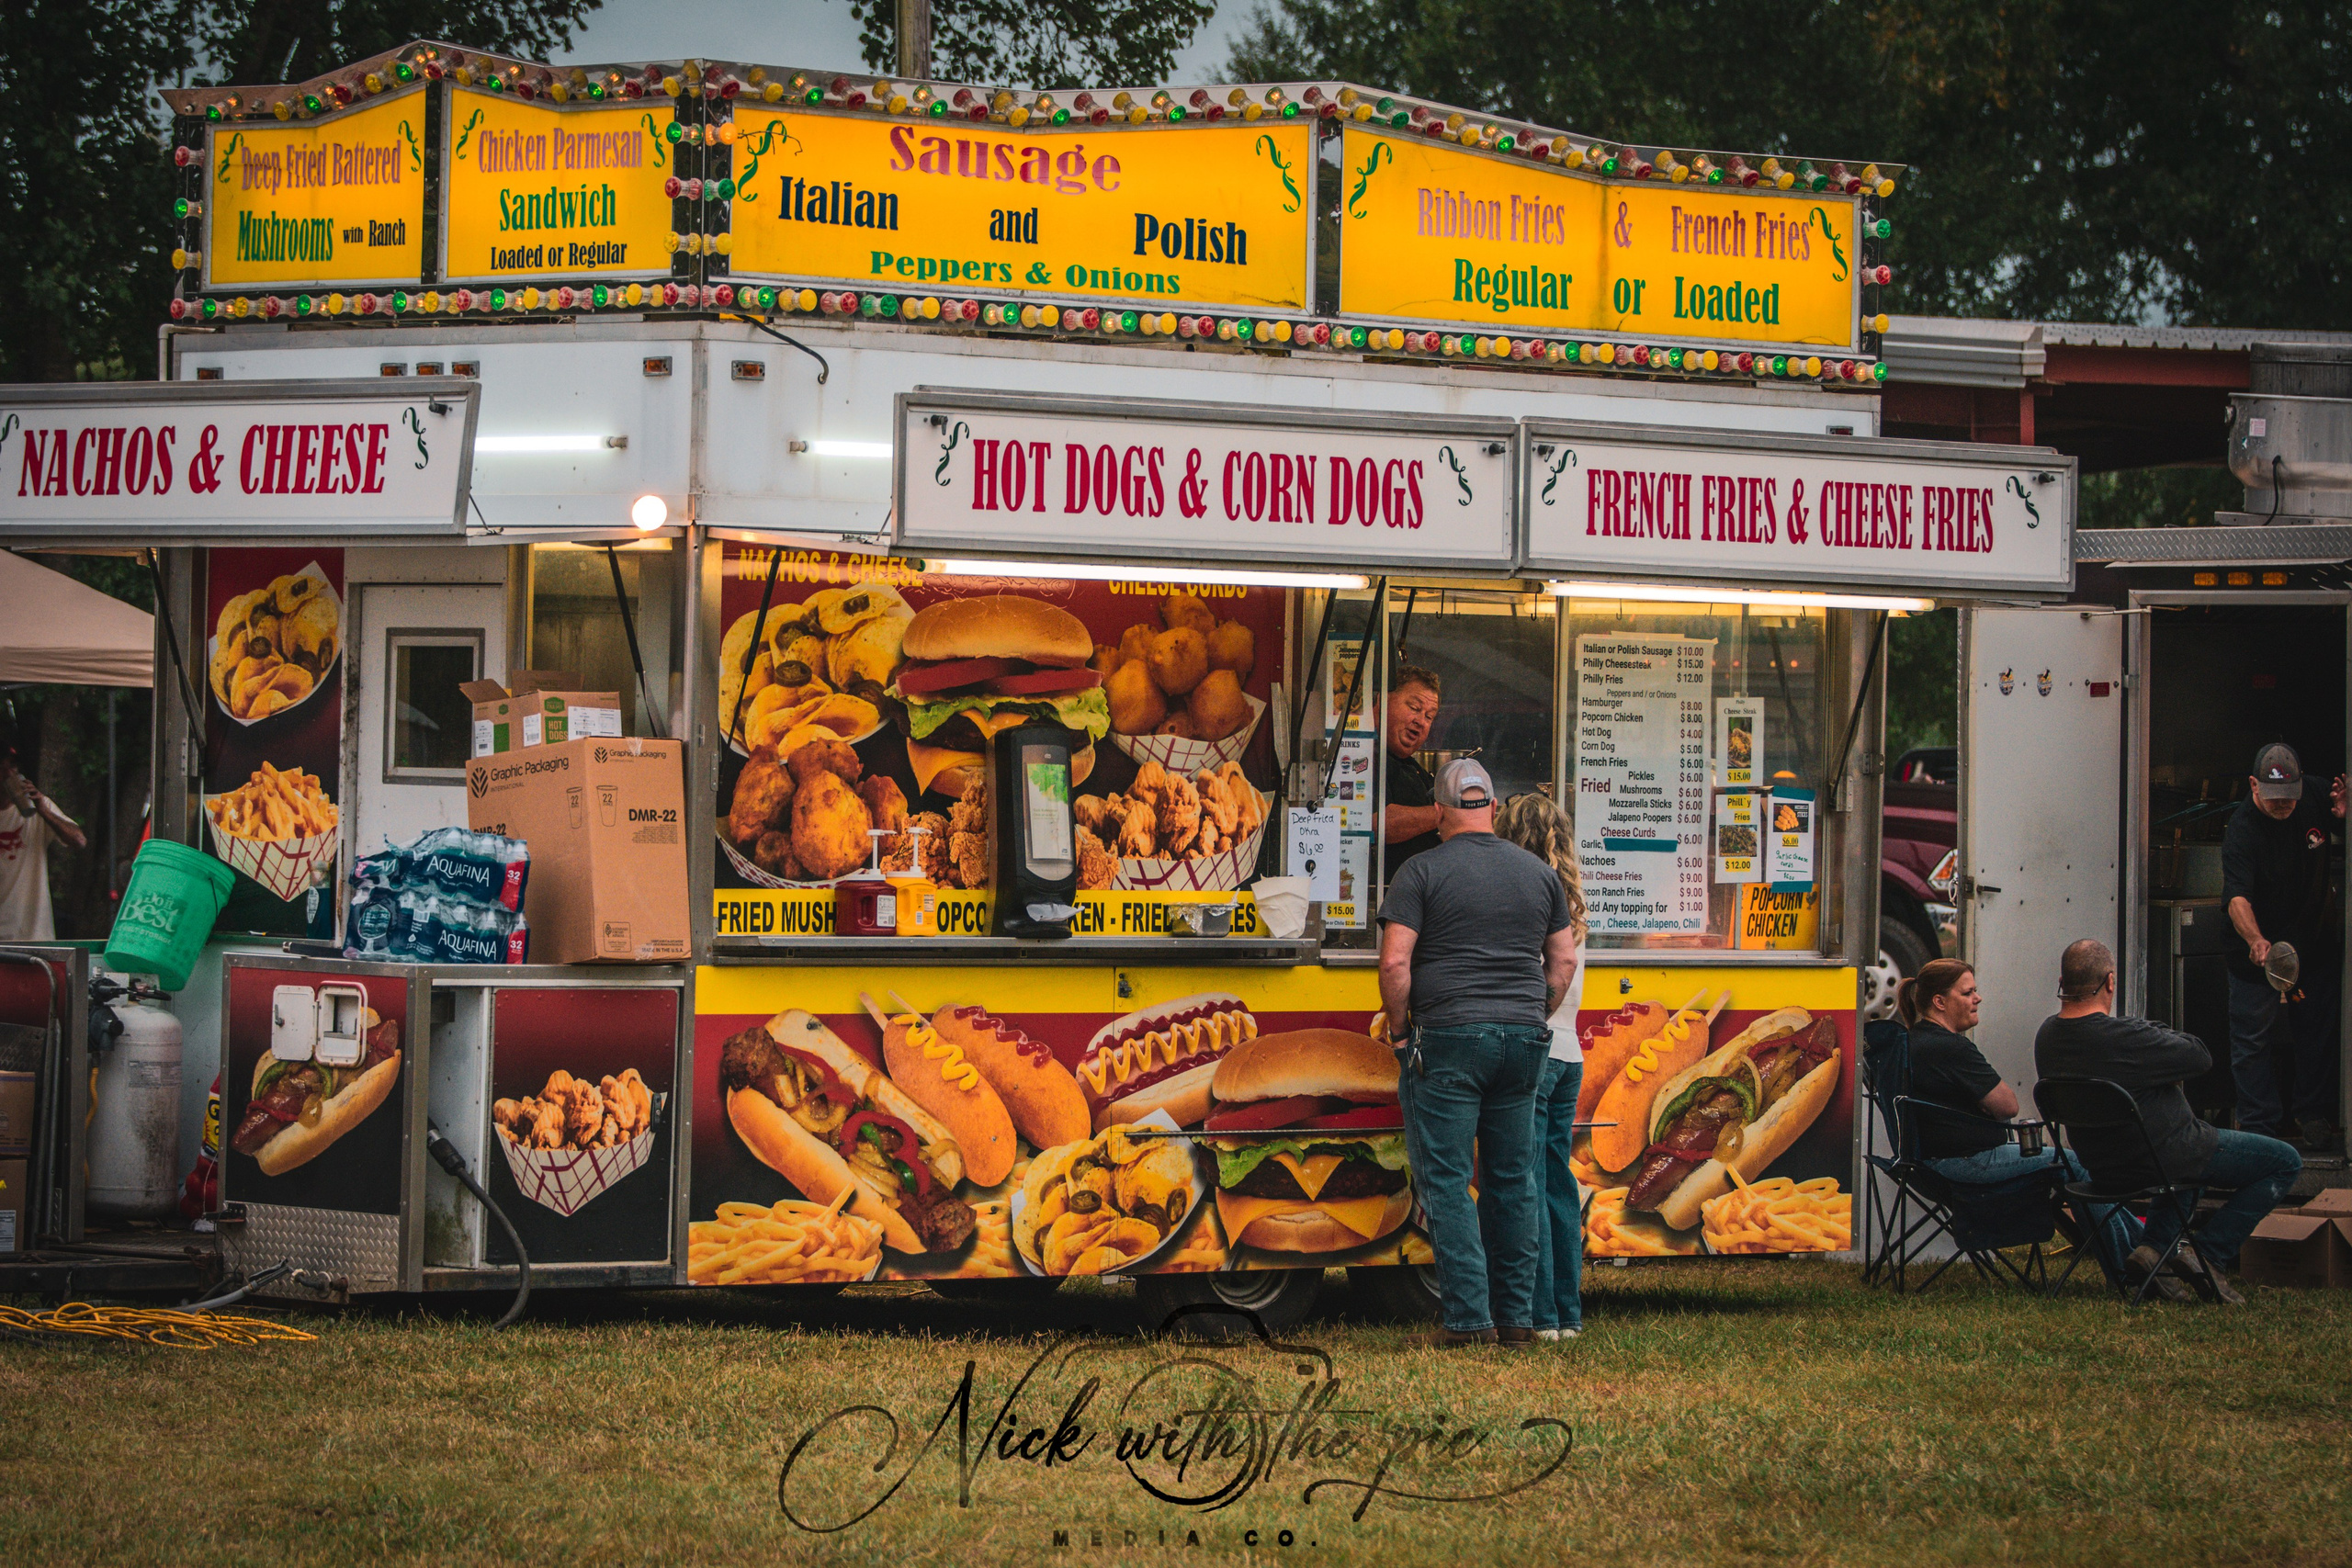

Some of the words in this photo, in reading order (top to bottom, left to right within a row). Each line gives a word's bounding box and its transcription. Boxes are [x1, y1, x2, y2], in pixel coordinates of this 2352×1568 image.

[479, 130, 546, 174] Chicken
[552, 128, 643, 170] Parmesan
[890, 126, 1121, 195] Sausage
[242, 145, 279, 195] Deep
[287, 144, 327, 189] Fried
[332, 140, 401, 187] Battered
[500, 185, 616, 232] Sandwich
[779, 176, 898, 231] Italian
[989, 208, 1037, 244] and
[1135, 213, 1247, 265] Polish
[1418, 187, 1501, 241] Ribbon
[1510, 194, 1565, 245] Fries
[1614, 202, 1632, 249] &
[1671, 206, 1746, 257] French
[1755, 212, 1810, 262] Fries
[238, 210, 334, 262] Mushrooms
[344, 227, 363, 244] with
[368, 219, 406, 247] Ranch
[491, 245, 544, 271] Loaded
[548, 247, 563, 266] or
[568, 242, 628, 268] Regular
[870, 251, 1011, 284] Peppers
[1025, 264, 1052, 285] &
[1066, 264, 1180, 294] Onions
[1453, 259, 1572, 312] Regular
[1613, 278, 1645, 315] or
[1675, 276, 1779, 325] Loaded
[18, 426, 175, 496] NACHOS
[189, 424, 224, 493] &
[240, 423, 389, 494] CHEESE
[972, 439, 1051, 513] HOT
[1064, 444, 1164, 518] DOGS
[1179, 448, 1208, 519] &
[1223, 451, 1316, 524] CORN
[1329, 456, 1423, 529] DOGS
[1586, 469, 1690, 540] FRENCH
[1702, 475, 1777, 544] FRIES
[1788, 478, 1808, 545] &
[1819, 480, 1912, 549] CHEESE
[1921, 486, 1993, 554] FRIES
[828, 553, 840, 583] &
[1584, 644, 1606, 653] Italian
[1618, 645, 1639, 654] Polish
[1642, 646, 1672, 658] Sausage
[1583, 659, 1603, 670] Philly
[1605, 659, 1651, 669] Cheesesteak
[1583, 674, 1603, 685] Philly
[1606, 675, 1623, 683] Fries
[1607, 689, 1631, 698] Peppers
[1582, 698, 1623, 709] Hamburger
[1582, 712, 1611, 723] Popcorn
[1614, 713, 1643, 722] Chicken
[548, 721, 562, 730] HOT
[1582, 728, 1595, 736] Hot
[1597, 728, 1611, 739] Dog
[1582, 741, 1599, 750] Corn
[1601, 742, 1614, 752] Dog
[610, 750, 632, 759] Graphic
[1581, 757, 1607, 766] French
[1609, 758, 1628, 767] Fries
[491, 764, 523, 781] Graphic
[526, 756, 569, 774] Packaging
[1628, 772, 1655, 780] Pickles
[491, 783, 524, 792] INTERNATIONAL
[1581, 778, 1611, 793] Fried
[1620, 785, 1662, 795] Mushrooms
[571, 795, 579, 805] 22
[603, 794, 612, 803] 22
[1609, 798, 1647, 808] Mozzarella
[1650, 799, 1672, 808] Sticks
[629, 808, 676, 822] DMR-22
[1292, 813, 1311, 824] Deep
[1314, 813, 1334, 823] Fried
[1608, 813, 1641, 823] Jalapeno
[1643, 813, 1672, 823] Poopers
[1600, 827, 1631, 837] Cheese
[1633, 828, 1656, 838] Curds
[1581, 840, 1602, 850] Garlic,
[1579, 855, 1615, 865] Nachoes
[427, 856, 490, 886] AQUAFINA
[507, 870, 520, 880] 32
[1596, 872, 1623, 881] Cheese
[1624, 872, 1642, 881] Fries
[1602, 887, 1624, 896] Ranch
[1627, 888, 1645, 897] Fries
[1750, 887, 1803, 910] POPCORN
[120, 894, 178, 932] Best
[1602, 903, 1619, 915] Any
[1621, 903, 1653, 915] topping
[1656, 902, 1668, 912] for
[718, 901, 775, 932] FRIED
[1608, 919, 1640, 930] Cheese,
[1642, 919, 1680, 931] Jalapeno,
[1683, 919, 1700, 929] Chili
[1747, 913, 1798, 937] CHICKEN
[438, 930, 497, 960] AQUAFINA
[510, 941, 522, 949] 32
